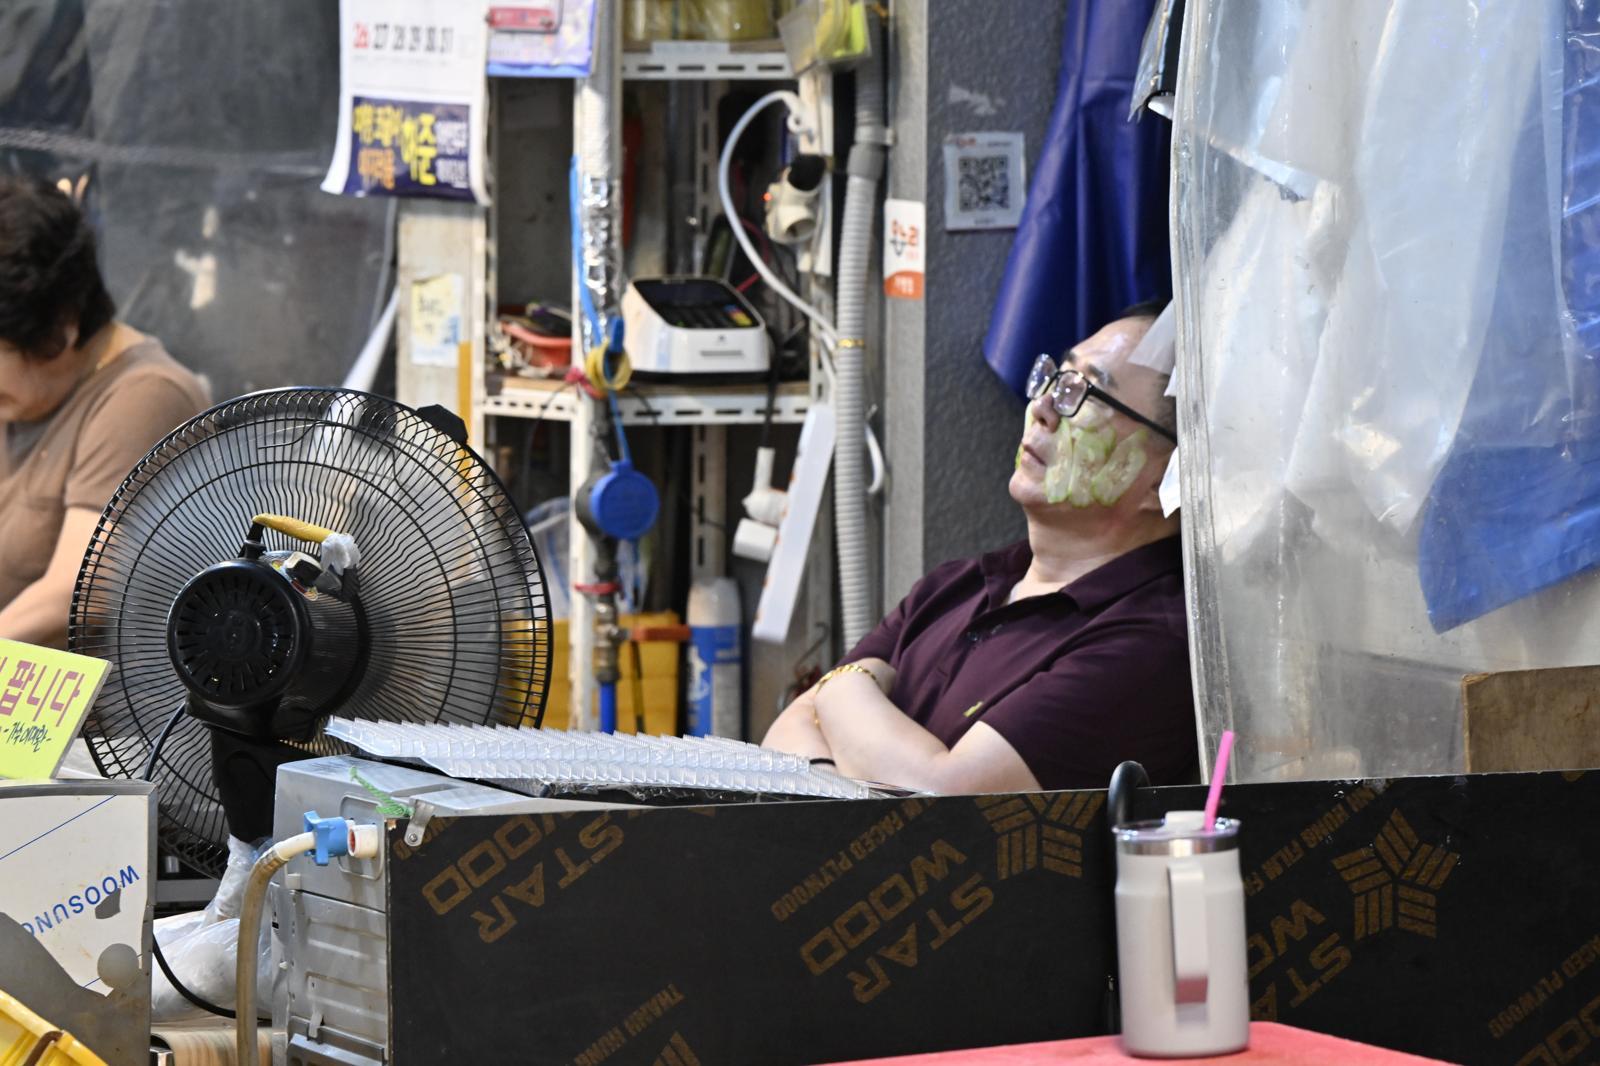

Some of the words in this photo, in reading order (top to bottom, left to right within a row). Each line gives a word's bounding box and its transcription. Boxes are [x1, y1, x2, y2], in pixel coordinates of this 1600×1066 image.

[0, 659, 85, 728] 팝니다
[470, 811, 624, 944] STAR
[850, 809, 904, 860] FACED
[771, 850, 853, 922] PLYWOOD
[800, 838, 968, 976] WOOD
[846, 872, 994, 1004] STAR
